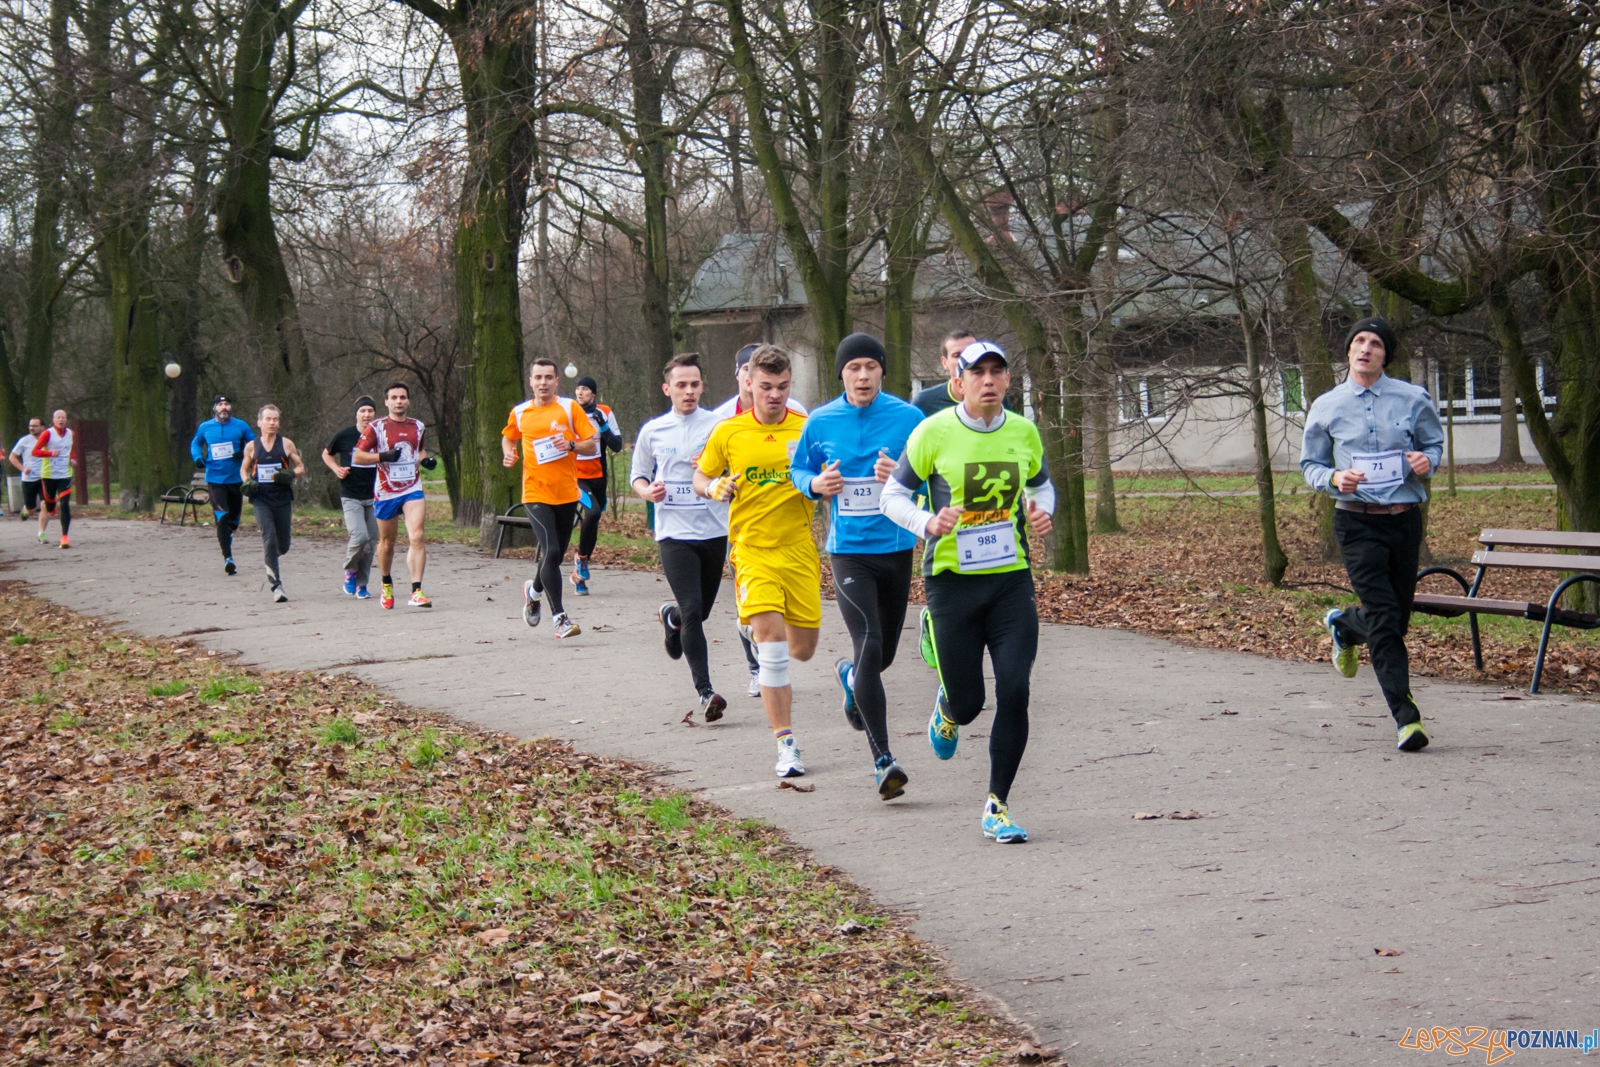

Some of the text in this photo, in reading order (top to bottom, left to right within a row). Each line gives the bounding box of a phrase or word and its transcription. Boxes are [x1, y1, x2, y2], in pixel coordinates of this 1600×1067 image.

[1372, 462, 1383, 471] 71
[745, 465, 791, 483] Carlsber
[853, 487, 872, 496] 423
[977, 534, 997, 546] 988
